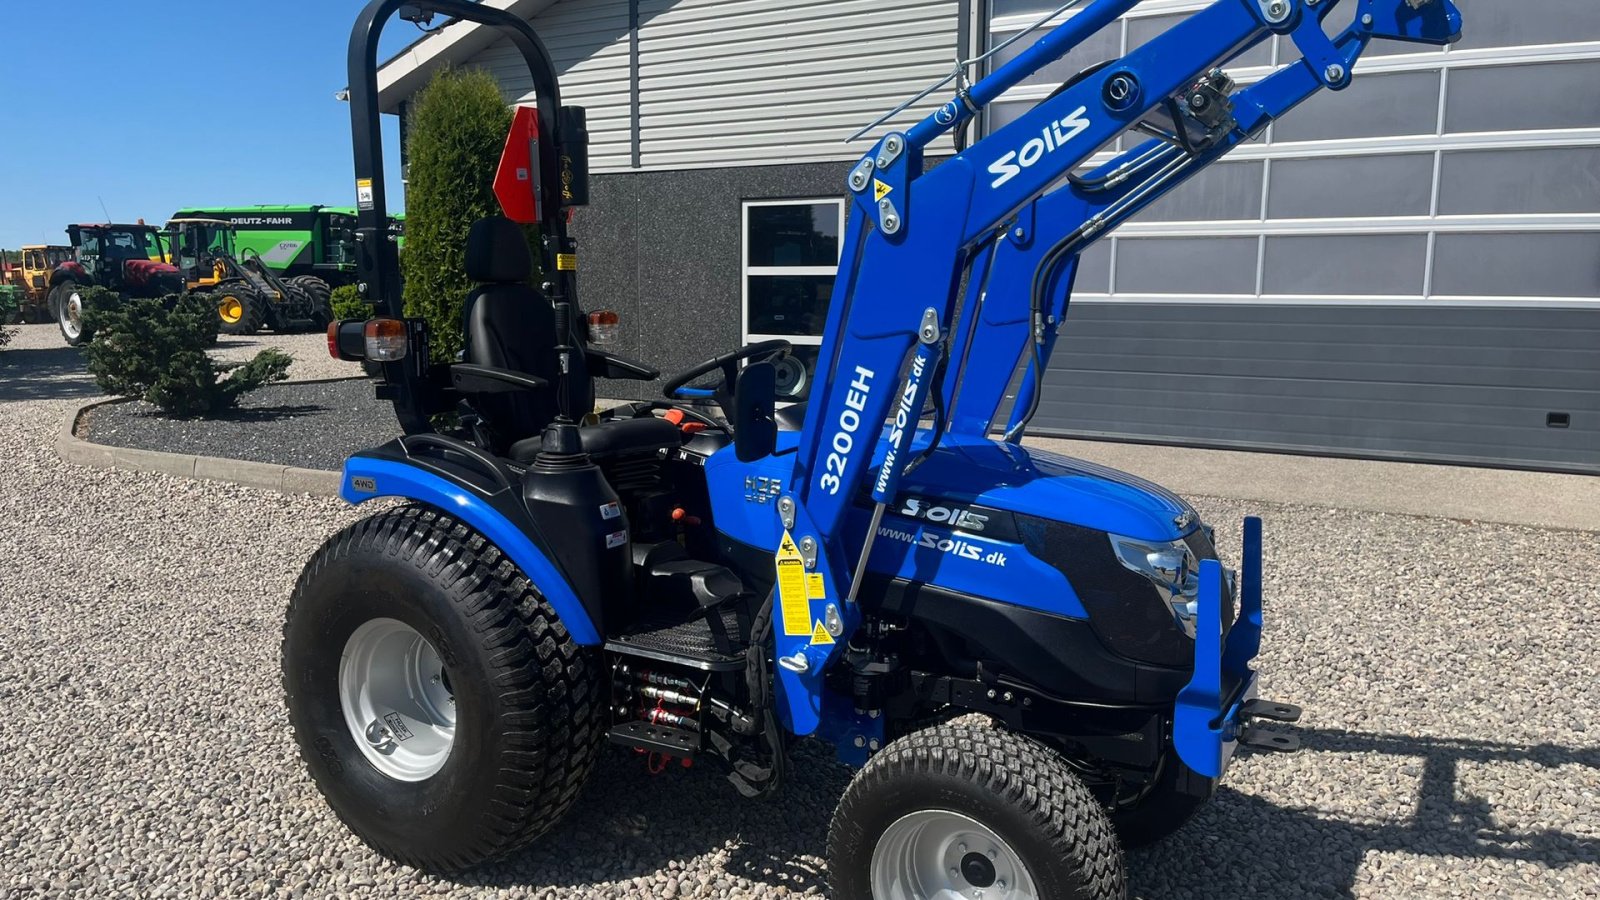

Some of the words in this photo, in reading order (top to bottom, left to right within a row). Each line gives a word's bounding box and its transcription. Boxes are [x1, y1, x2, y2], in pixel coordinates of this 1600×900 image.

[230, 217, 292, 225] DEUTZ-FAHR
[819, 365, 874, 495] 3200EH
[354, 479, 374, 489] 4WD
